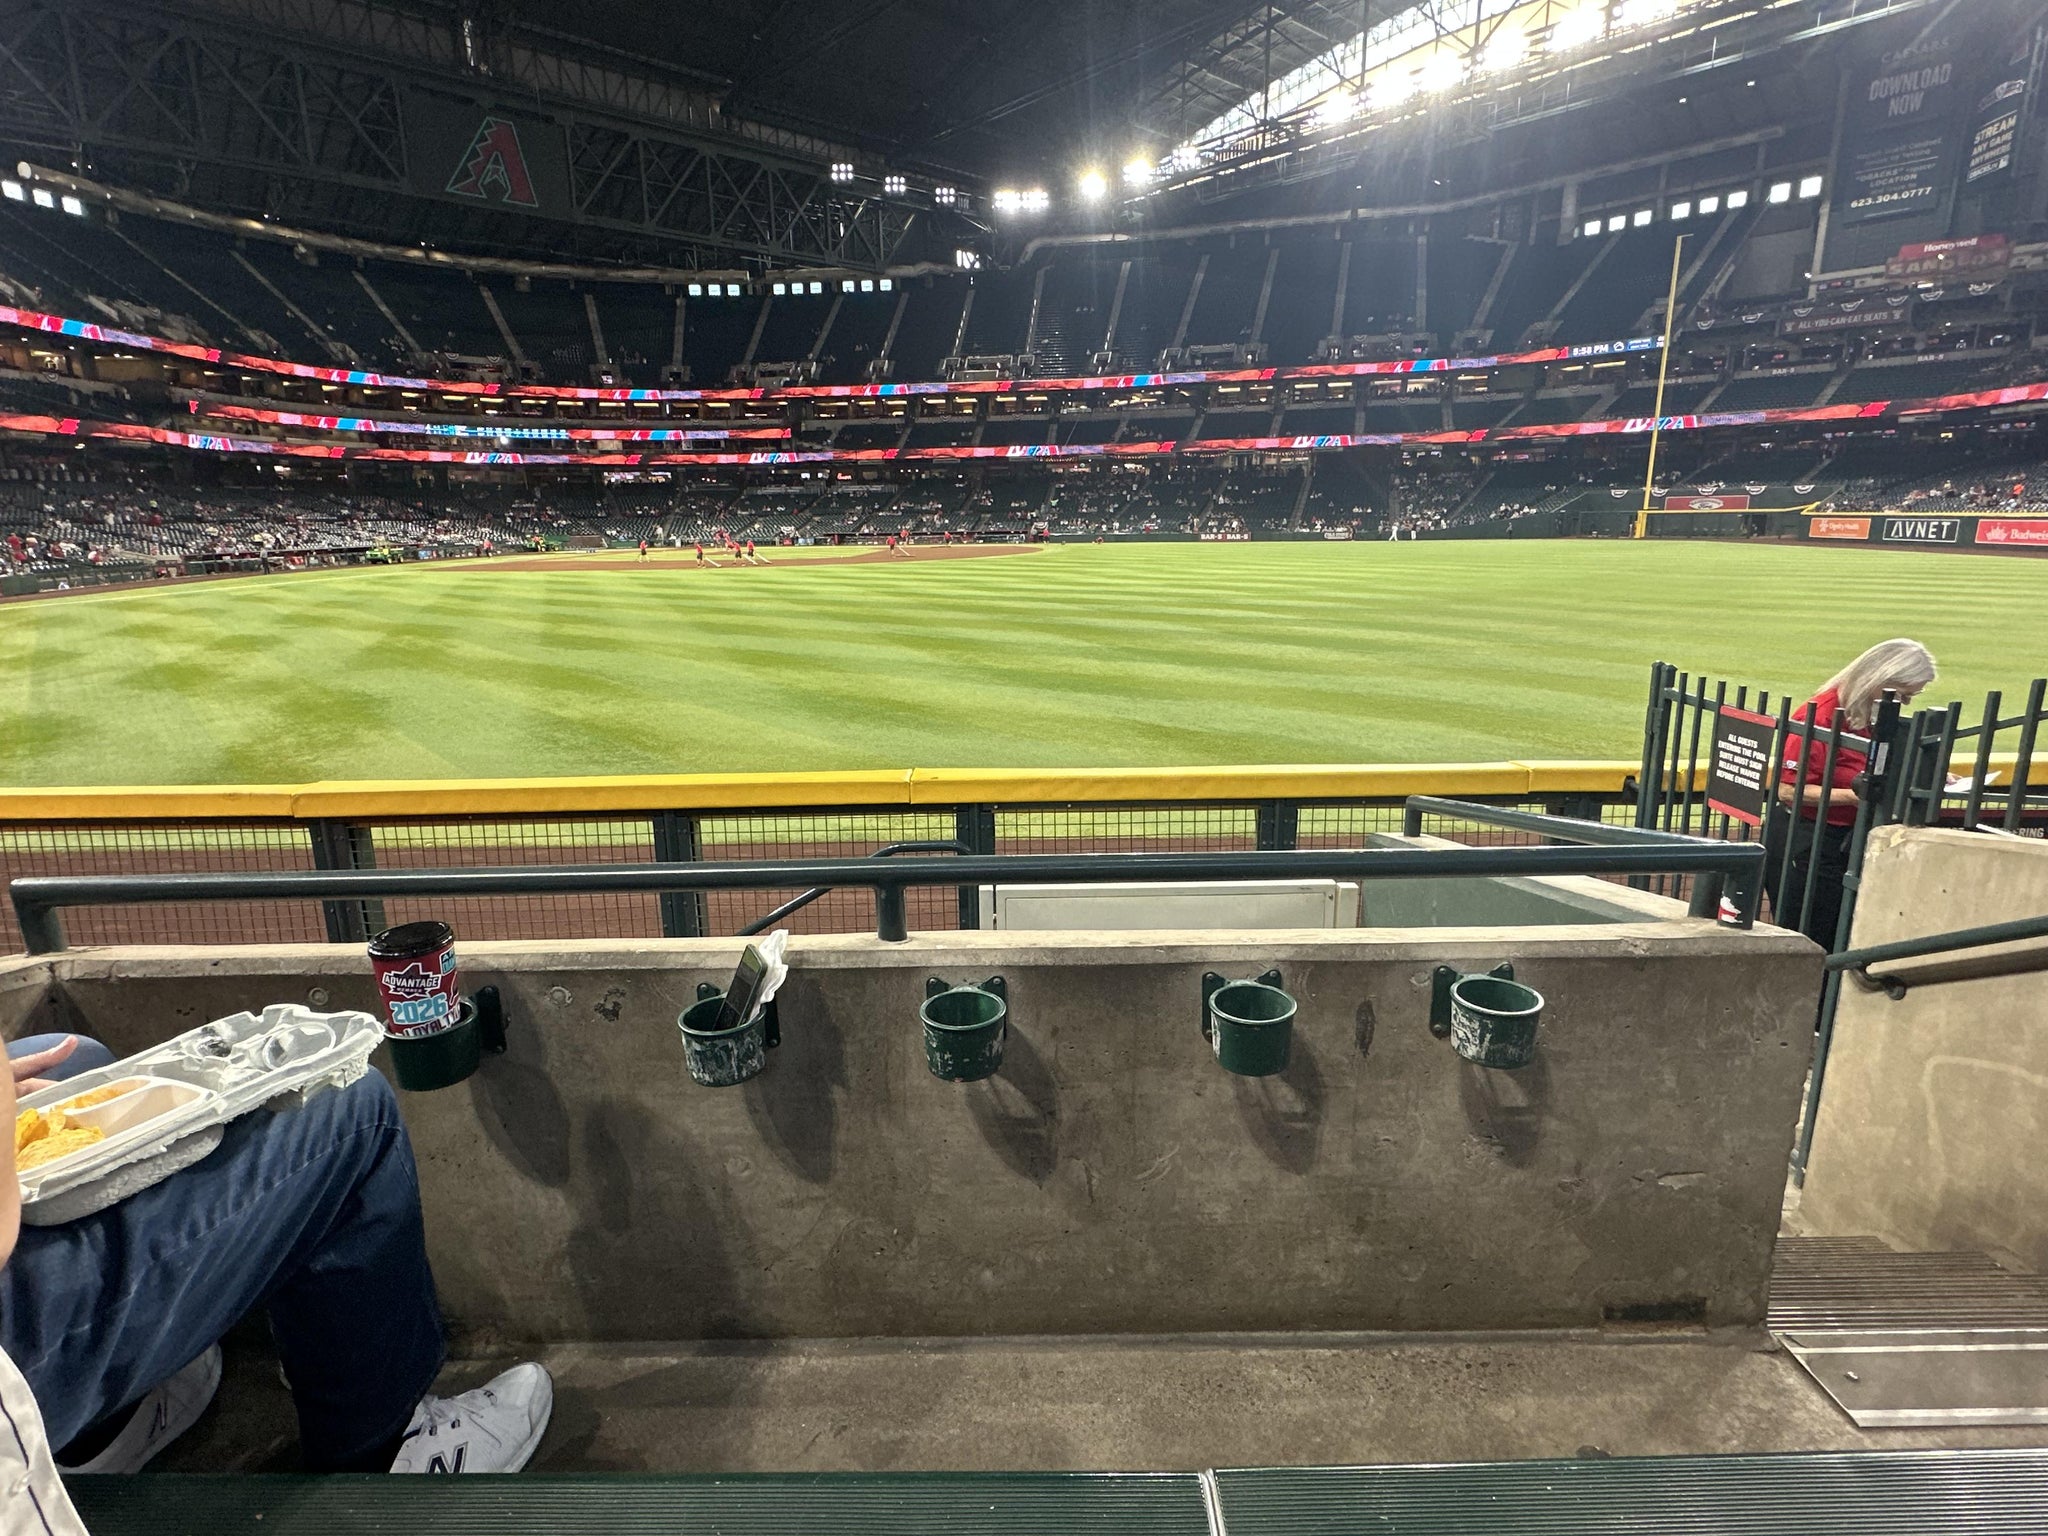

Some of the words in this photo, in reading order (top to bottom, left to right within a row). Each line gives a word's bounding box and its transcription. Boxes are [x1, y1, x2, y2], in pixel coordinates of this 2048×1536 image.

[1869, 63, 1952, 101] DOWNLOAD
[1888, 91, 1925, 117] NOW
[1974, 114, 2017, 145] STREAM
[1971, 141, 1989, 156] ANY
[1990, 130, 2014, 147] GAME
[1869, 173, 1918, 188] LOCATION
[1850, 186, 1933, 208] 623.304.0777
[1924, 237, 1978, 252] Honeywell
[1864, 312, 1888, 322] SEATS
[1593, 343, 1609, 354] PM
[1890, 521, 1951, 539] AVNET
[1718, 740, 1741, 754] ENTERING
[1742, 747, 1752, 757] THE
[1752, 750, 1766, 762] POOL
[1728, 733, 1737, 742] ALL
[1737, 736, 1758, 749] GUESTS
[1719, 750, 1734, 761] SUITE
[1734, 755, 1749, 766] MUST
[1716, 769, 1735, 782] BEFORE
[1734, 775, 1760, 790] ENTERING
[1718, 760, 1740, 774] RELEASE
[1740, 767, 1760, 780] WAIVER
[384, 975, 438, 988] ADVANTAGE
[389, 992, 449, 1025] 2026
